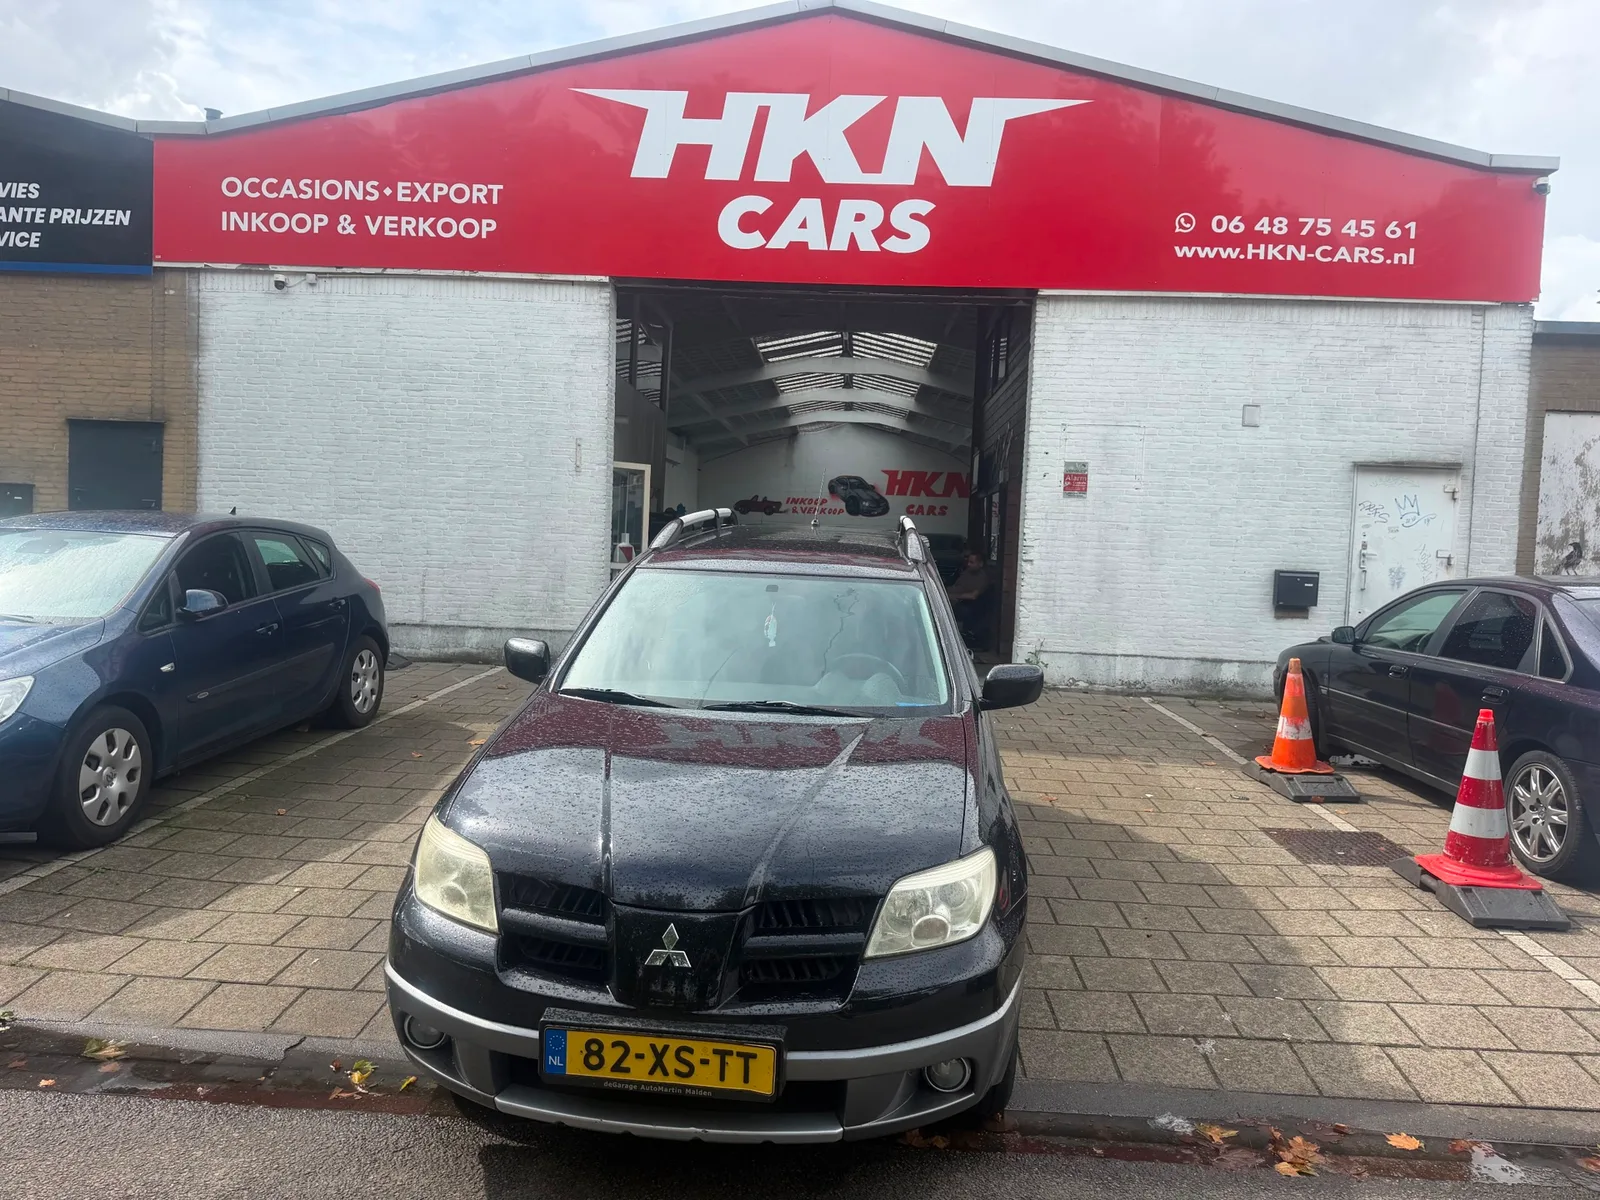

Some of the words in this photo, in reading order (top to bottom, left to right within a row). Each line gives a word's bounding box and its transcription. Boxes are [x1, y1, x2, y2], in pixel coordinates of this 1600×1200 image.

[568, 87, 1096, 187] HKN
[221, 176, 379, 201] OCCASIONS
[397, 181, 504, 205] EXPORT
[48, 208, 132, 226] PRIJZEN
[221, 211, 329, 234] INKOOP
[336, 214, 357, 235] &
[364, 215, 498, 239] VERKOOP
[717, 195, 937, 253] CARS
[1211, 214, 1246, 234] 06
[1253, 216, 1289, 235] 48
[1298, 217, 1332, 237] 75
[1341, 219, 1376, 238] 45
[1384, 220, 1417, 239] 61
[1174, 243, 1416, 265] www.HKN-CARS.nl
[881, 469, 970, 498] HKN
[905, 504, 949, 517] CARS
[548, 1055, 564, 1067] NL
[582, 1038, 758, 1084] 82-XS-TT
[603, 1081, 638, 1090] deGarage
[640, 1084, 683, 1094] AutoMartin
[685, 1088, 713, 1097] Malden
